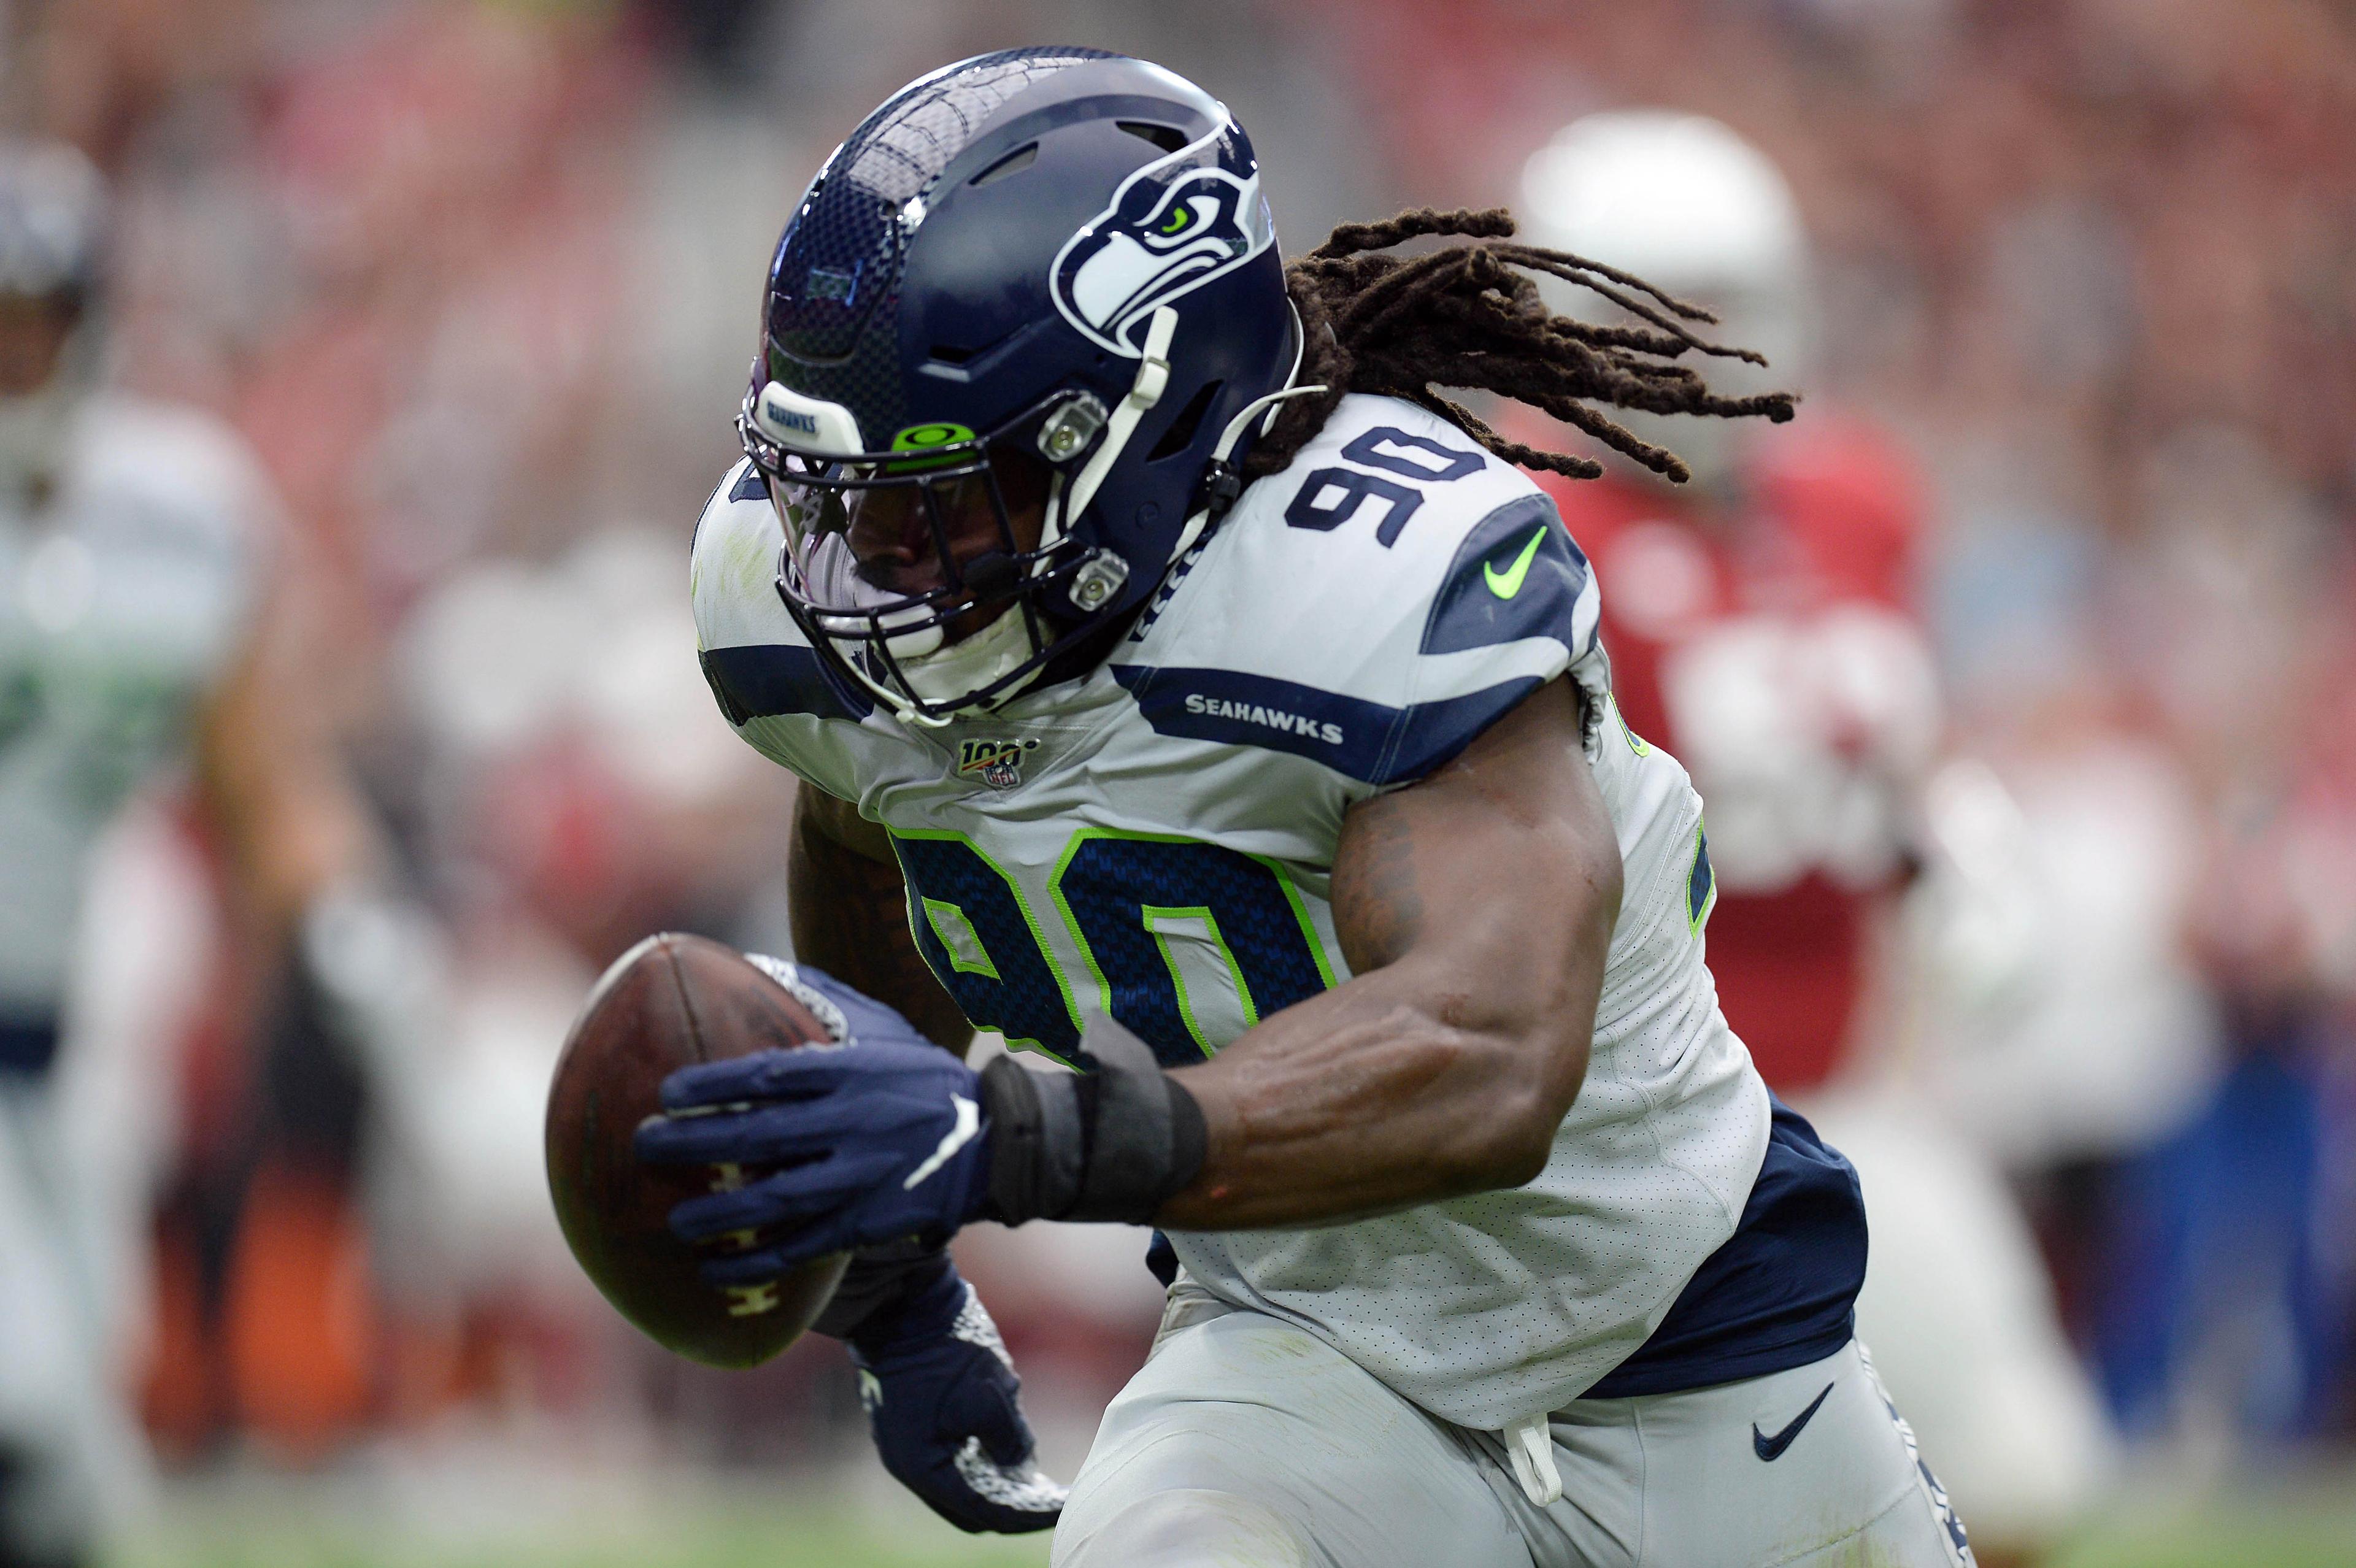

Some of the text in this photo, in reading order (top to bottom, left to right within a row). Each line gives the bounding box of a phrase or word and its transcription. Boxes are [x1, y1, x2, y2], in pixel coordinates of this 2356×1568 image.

[1284, 426, 1487, 548] 90
[1185, 693, 1344, 745] SEAHAWKS
[990, 774, 1015, 785] NFL
[885, 826, 1339, 1075] 90
